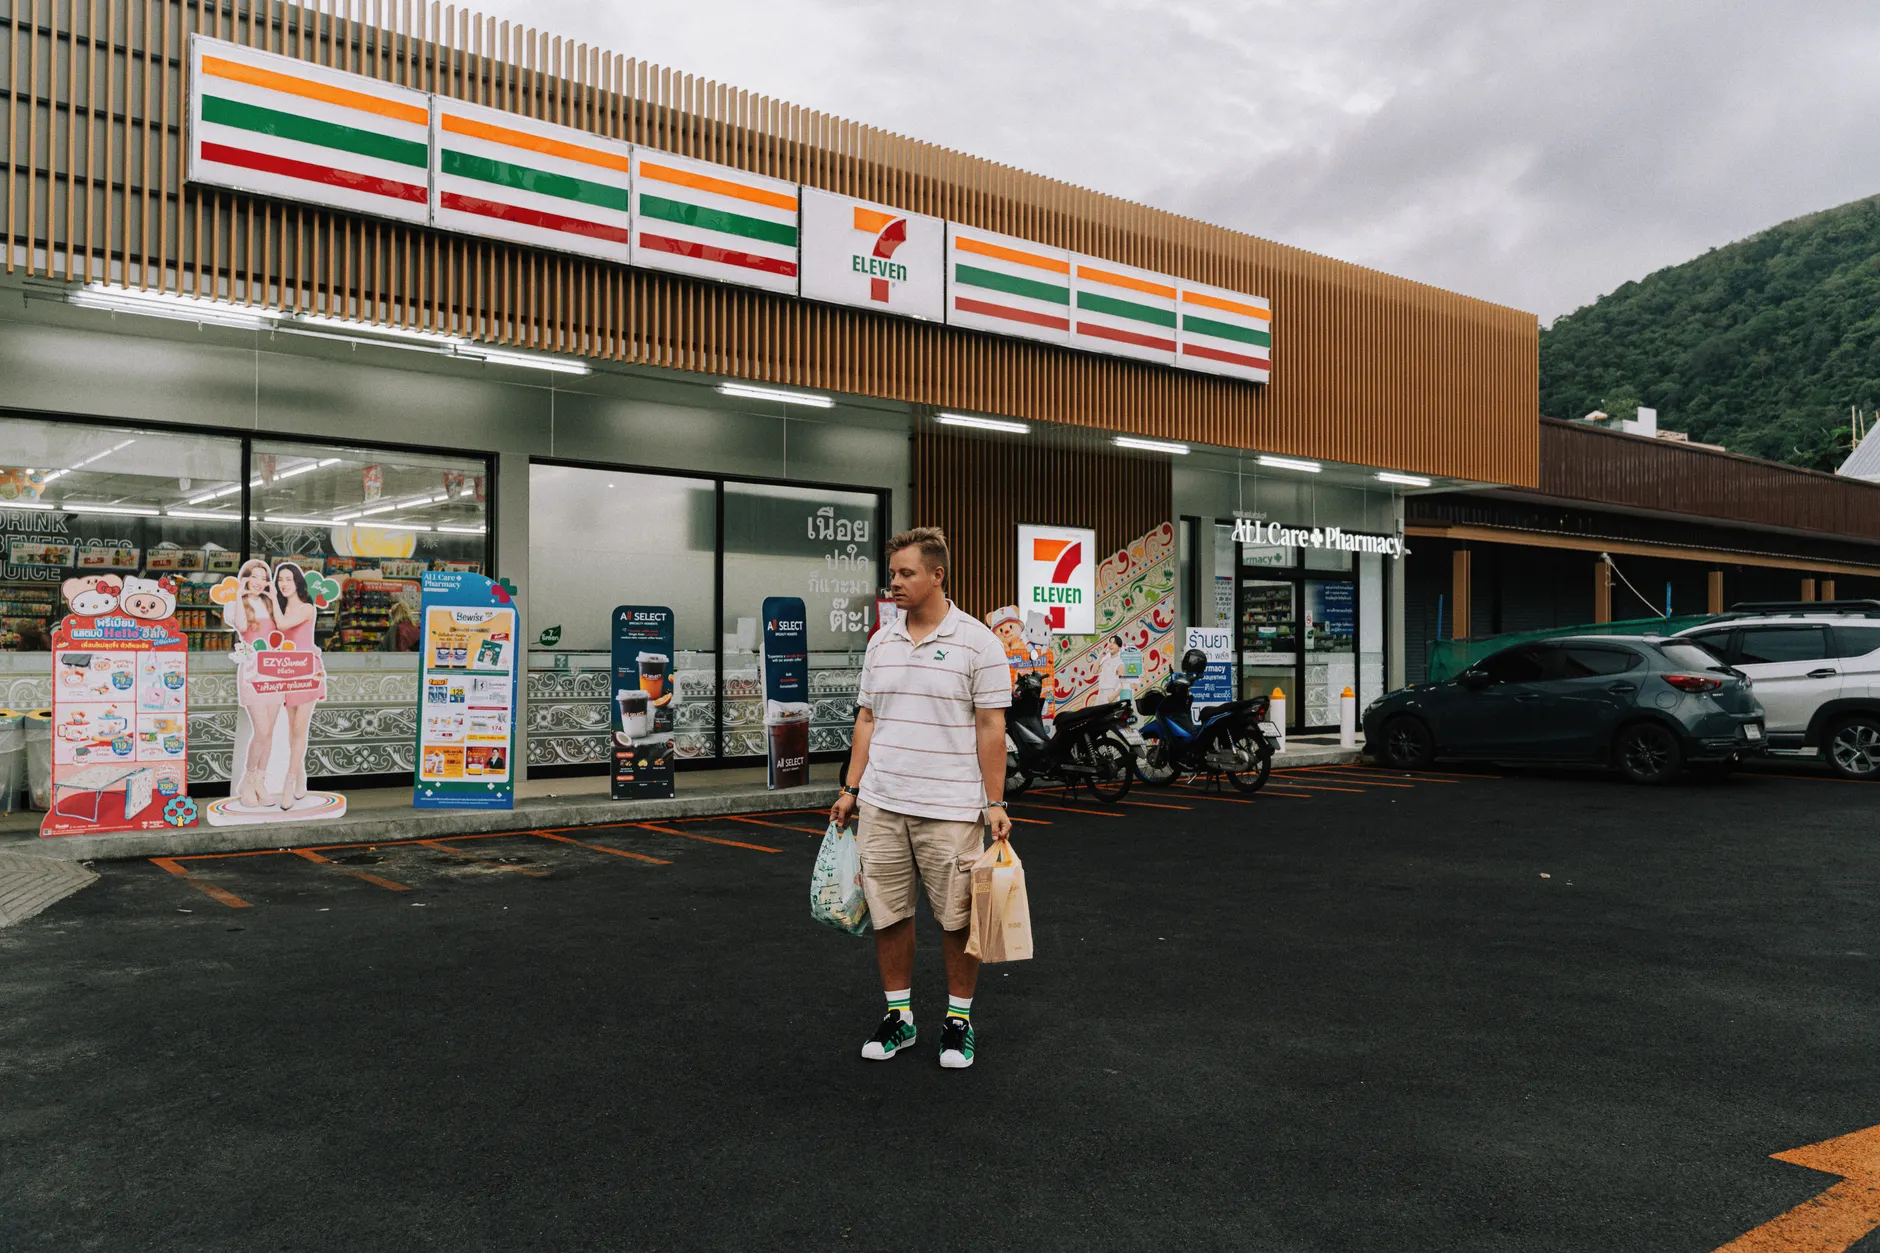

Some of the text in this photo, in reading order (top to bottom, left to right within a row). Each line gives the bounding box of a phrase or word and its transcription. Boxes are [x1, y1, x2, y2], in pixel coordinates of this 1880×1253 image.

[854, 206, 906, 303] 7
[1268, 522, 1308, 548] Care
[1325, 526, 1403, 560] Pharmacy
[424, 580, 460, 589] Pharmacy
[634, 612, 666, 621] SELECT
[779, 621, 803, 630] SELECT
[104, 627, 140, 638] Hello
[1189, 630, 1228, 648] ร้านยา
[263, 656, 308, 666] EZY Sweet
[1204, 665, 1226, 675] rmacy
[786, 757, 804, 767] SELECT
